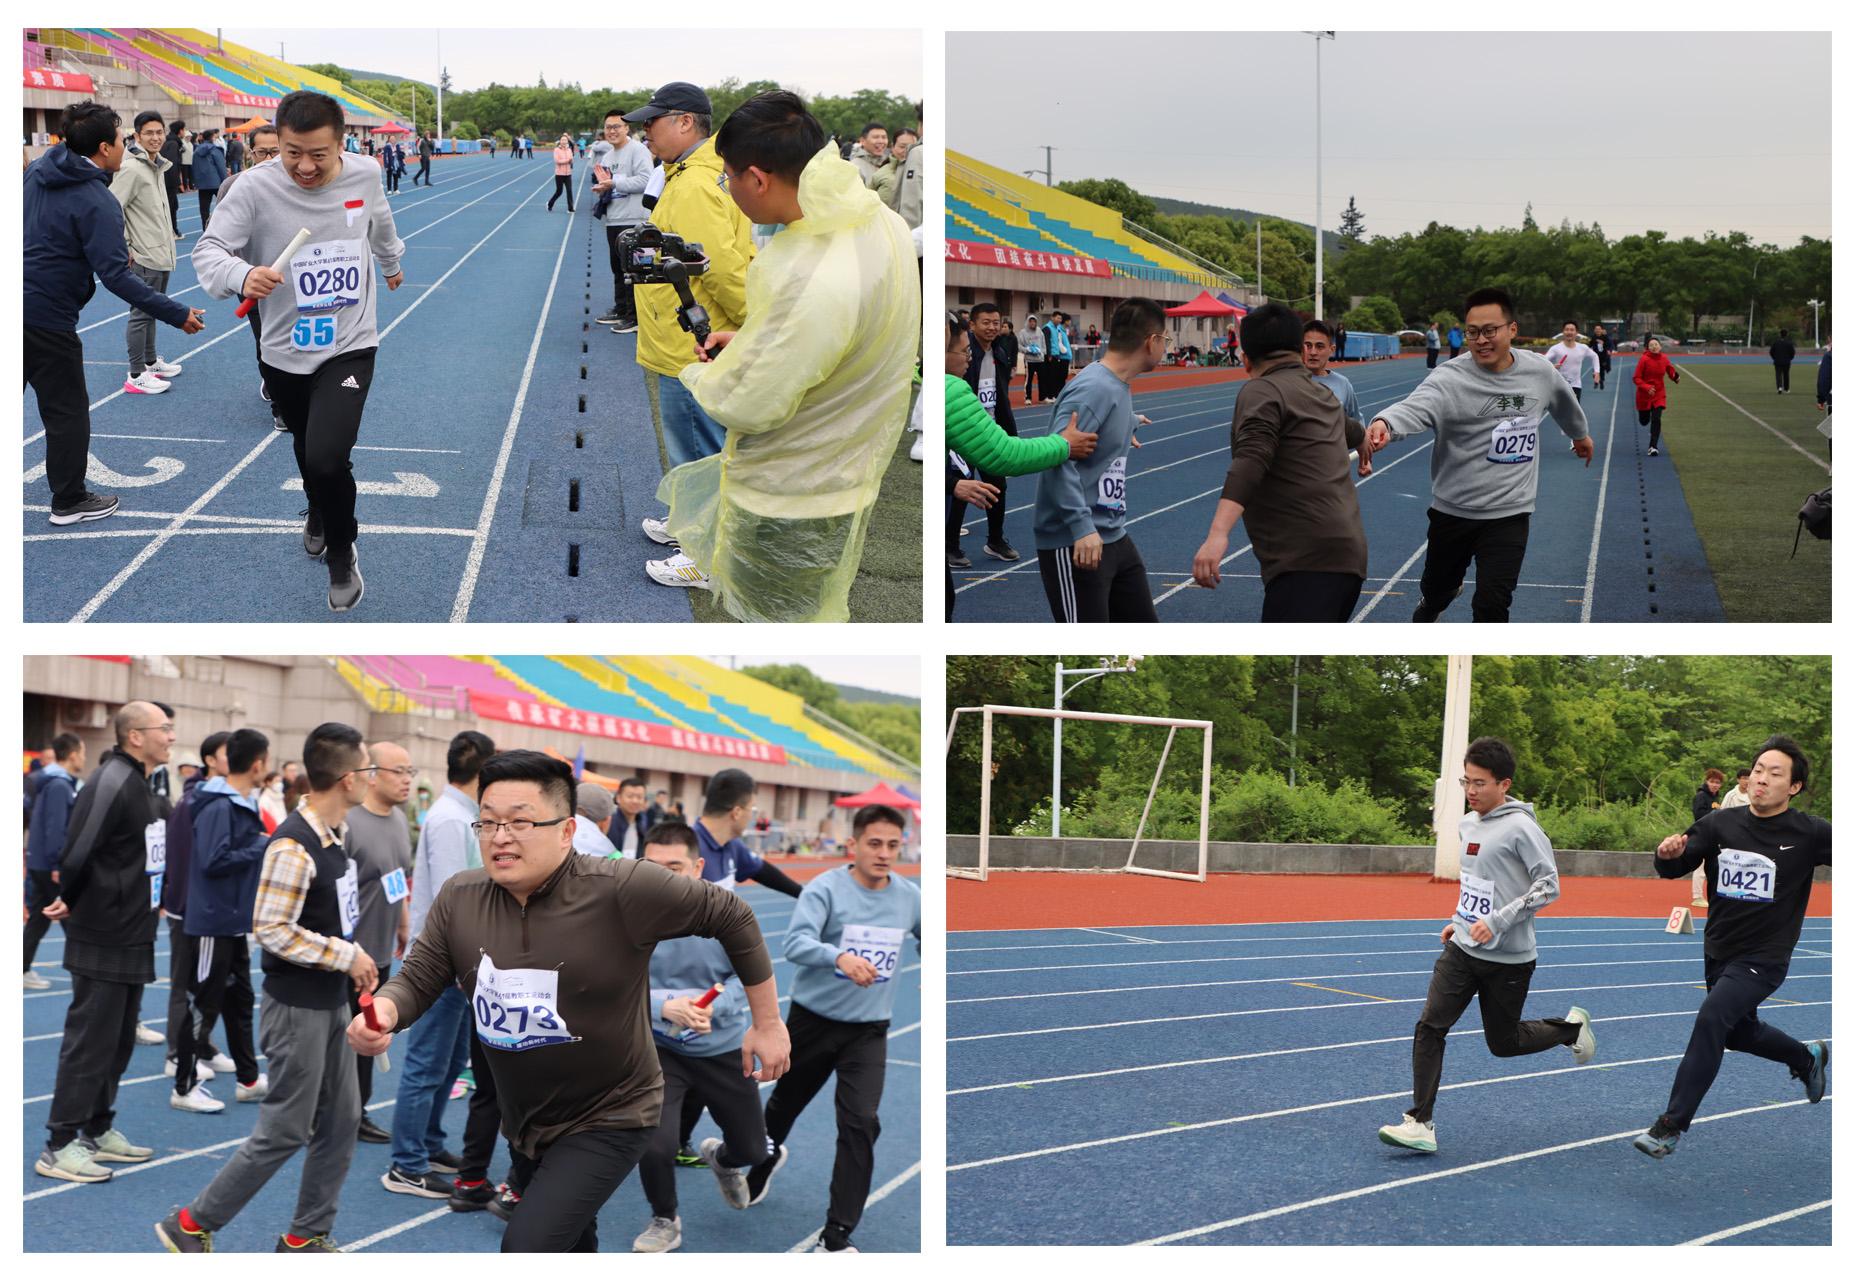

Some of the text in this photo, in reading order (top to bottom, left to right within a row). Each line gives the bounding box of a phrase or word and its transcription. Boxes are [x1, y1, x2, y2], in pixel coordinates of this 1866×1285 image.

[23, 70, 66, 88] 素质
[299, 266, 359, 297] 0280
[293, 317, 334, 347] 55
[1495, 433, 1536, 455] 0279
[1103, 477, 1126, 501] 05
[1721, 868, 1769, 892] 0421
[1670, 910, 1682, 929] 8
[476, 994, 559, 1035] 0273
